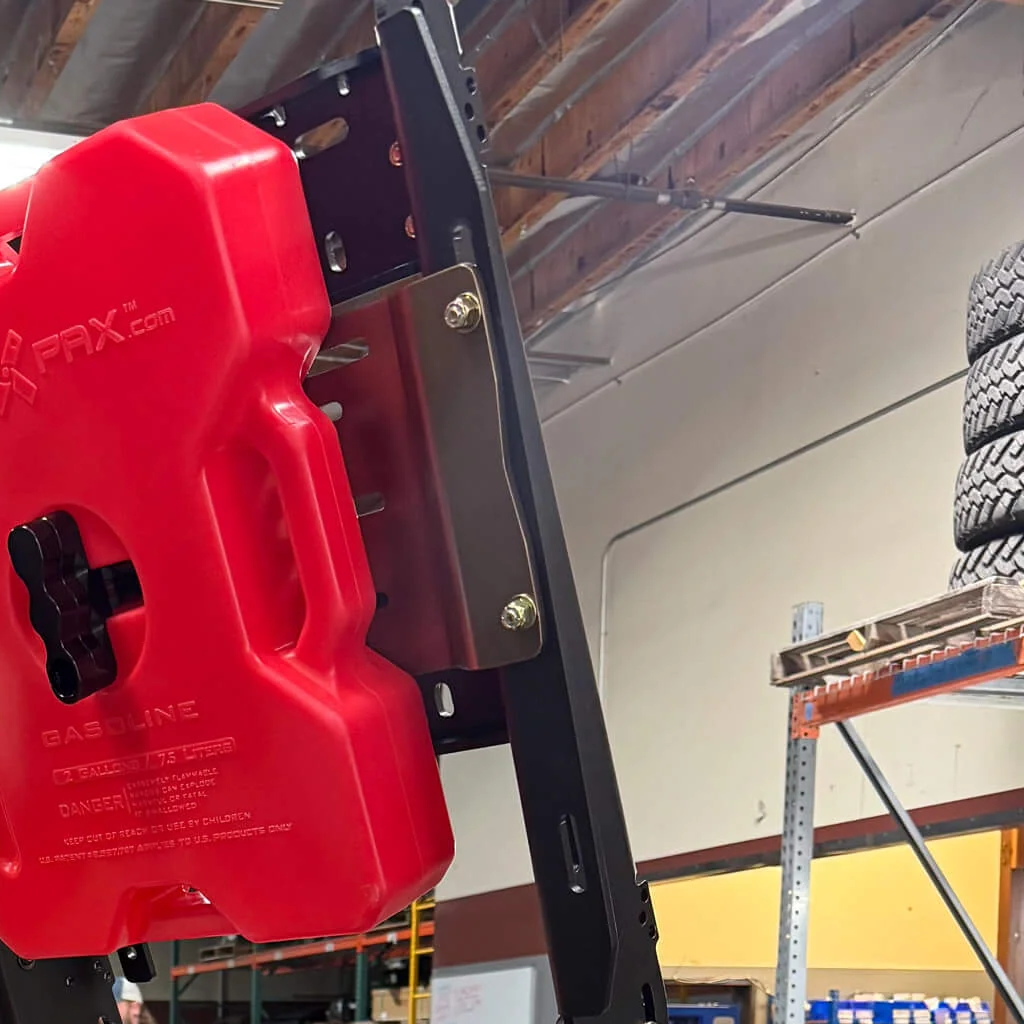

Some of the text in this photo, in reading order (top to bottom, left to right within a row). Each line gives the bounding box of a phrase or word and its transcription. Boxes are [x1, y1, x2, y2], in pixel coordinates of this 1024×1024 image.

[41, 700, 200, 748] GASOLINE
[182, 741, 232, 761] LITERS
[58, 793, 125, 819] DANGER
[64, 836, 84, 847] KEEP
[202, 811, 252, 826] CHILDREN
